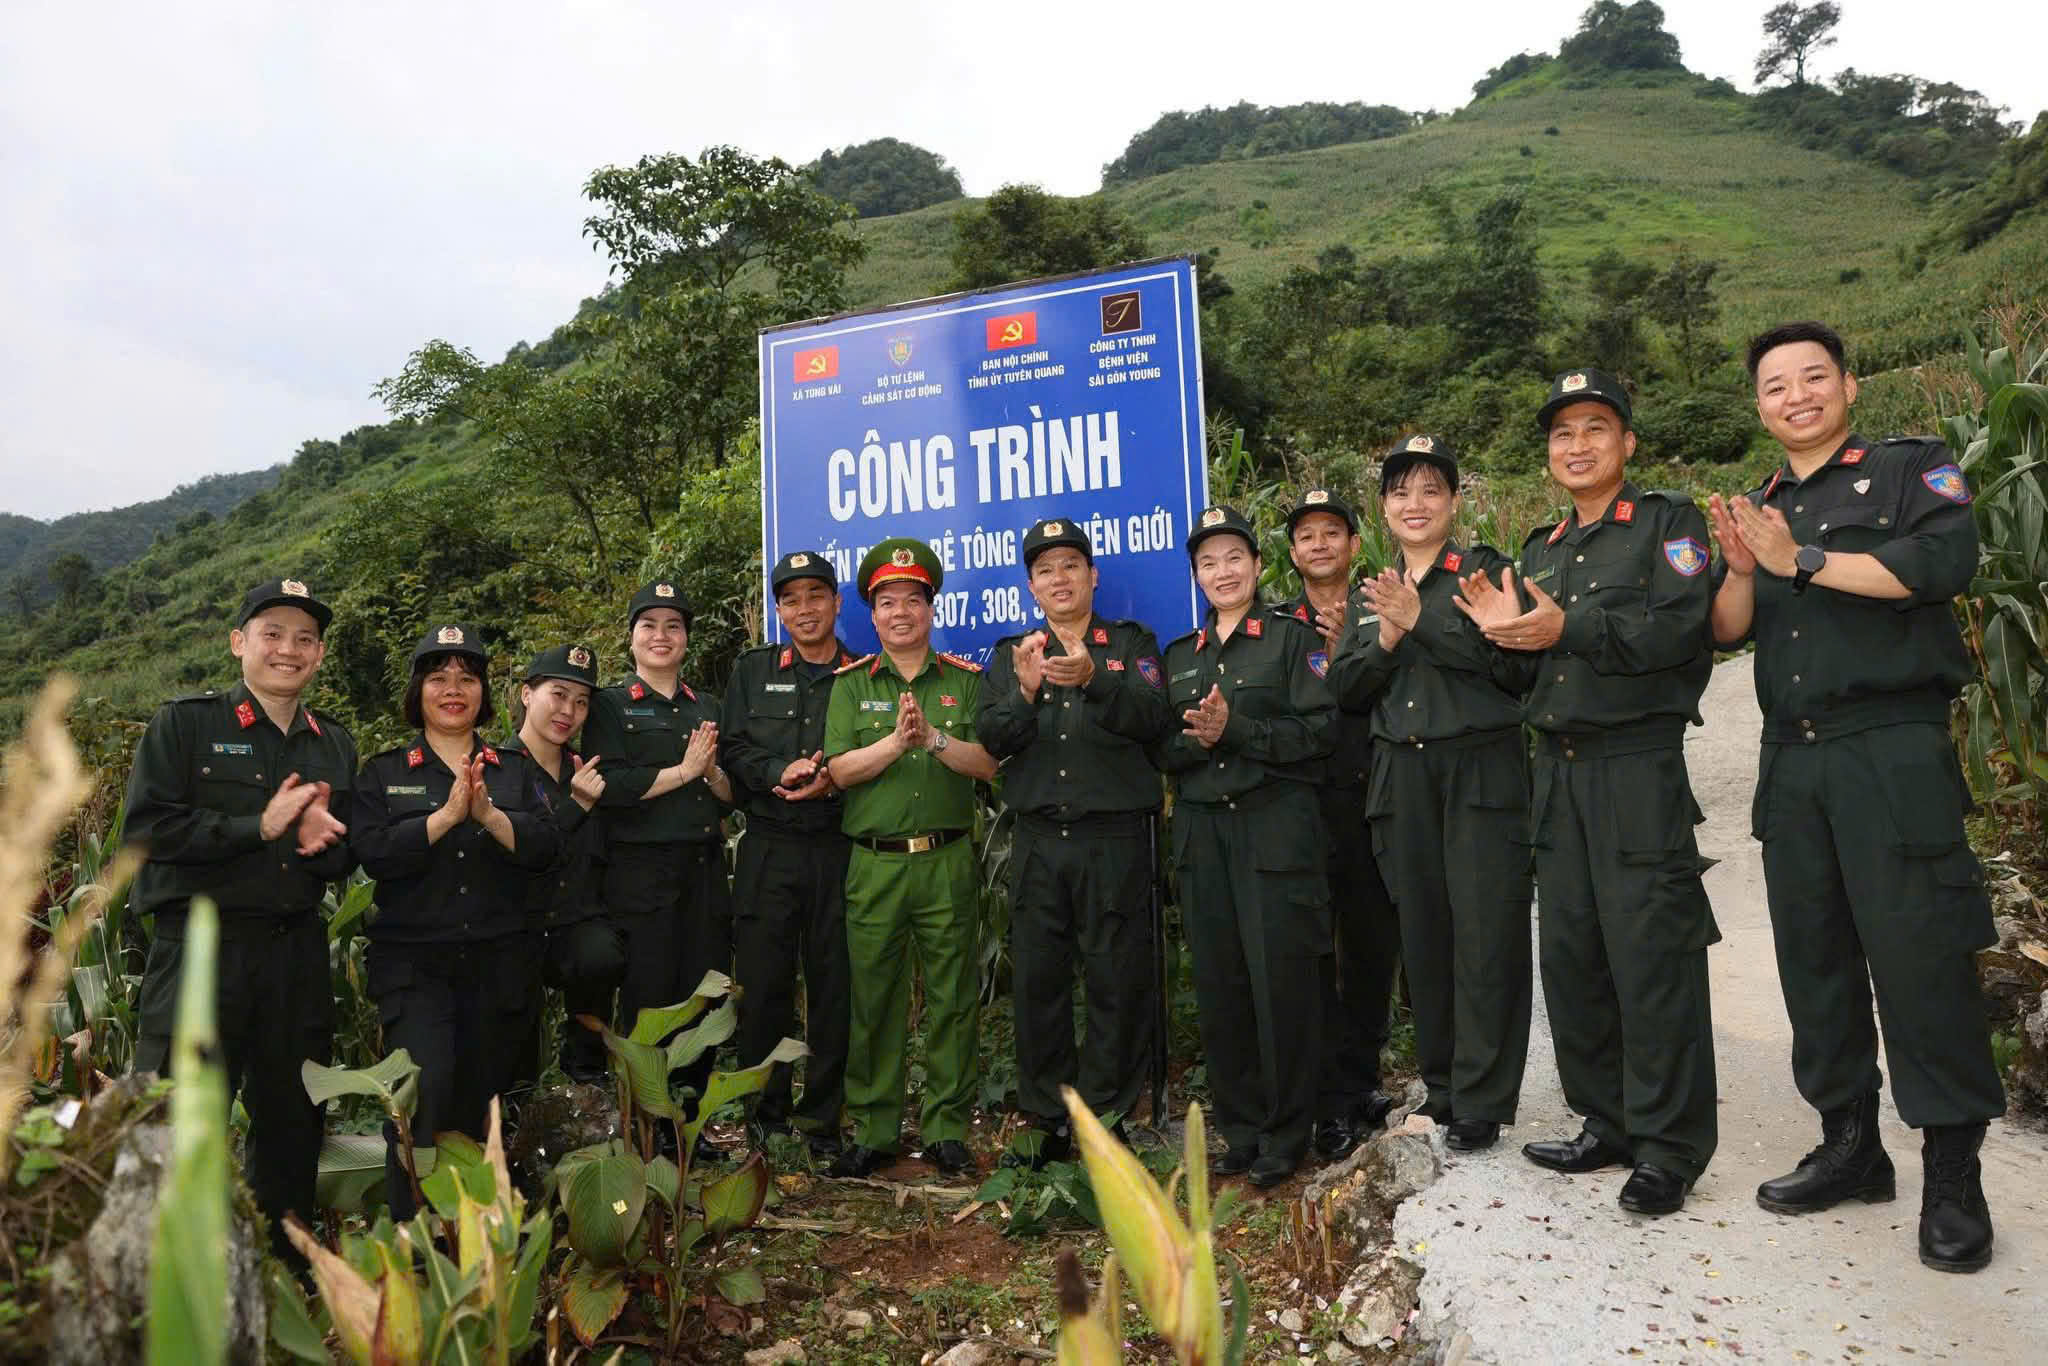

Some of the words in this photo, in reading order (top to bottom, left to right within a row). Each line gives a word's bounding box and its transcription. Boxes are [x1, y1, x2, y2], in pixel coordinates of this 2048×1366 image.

[1089, 340, 1116, 354] CÔNG
[1118, 336, 1129, 349] TY
[1131, 333, 1157, 347] TNHH
[981, 358, 1001, 371] BAN
[1003, 354, 1018, 369] NỘI
[1021, 350, 1049, 365] CHÍNH
[1098, 355, 1124, 370] BỆNH
[1126, 351, 1148, 367] VIỆN
[1004, 368, 1033, 383] TUYÊN
[1034, 364, 1065, 380] QUANG
[1128, 367, 1161, 381] YOUNG
[827, 429, 955, 522] CÔNG
[969, 406, 1122, 504] TRÌNH
[961, 525, 1016, 570] TÔNG
[1127, 506, 1174, 554] GIỚI
[982, 586, 1028, 625] 308,
